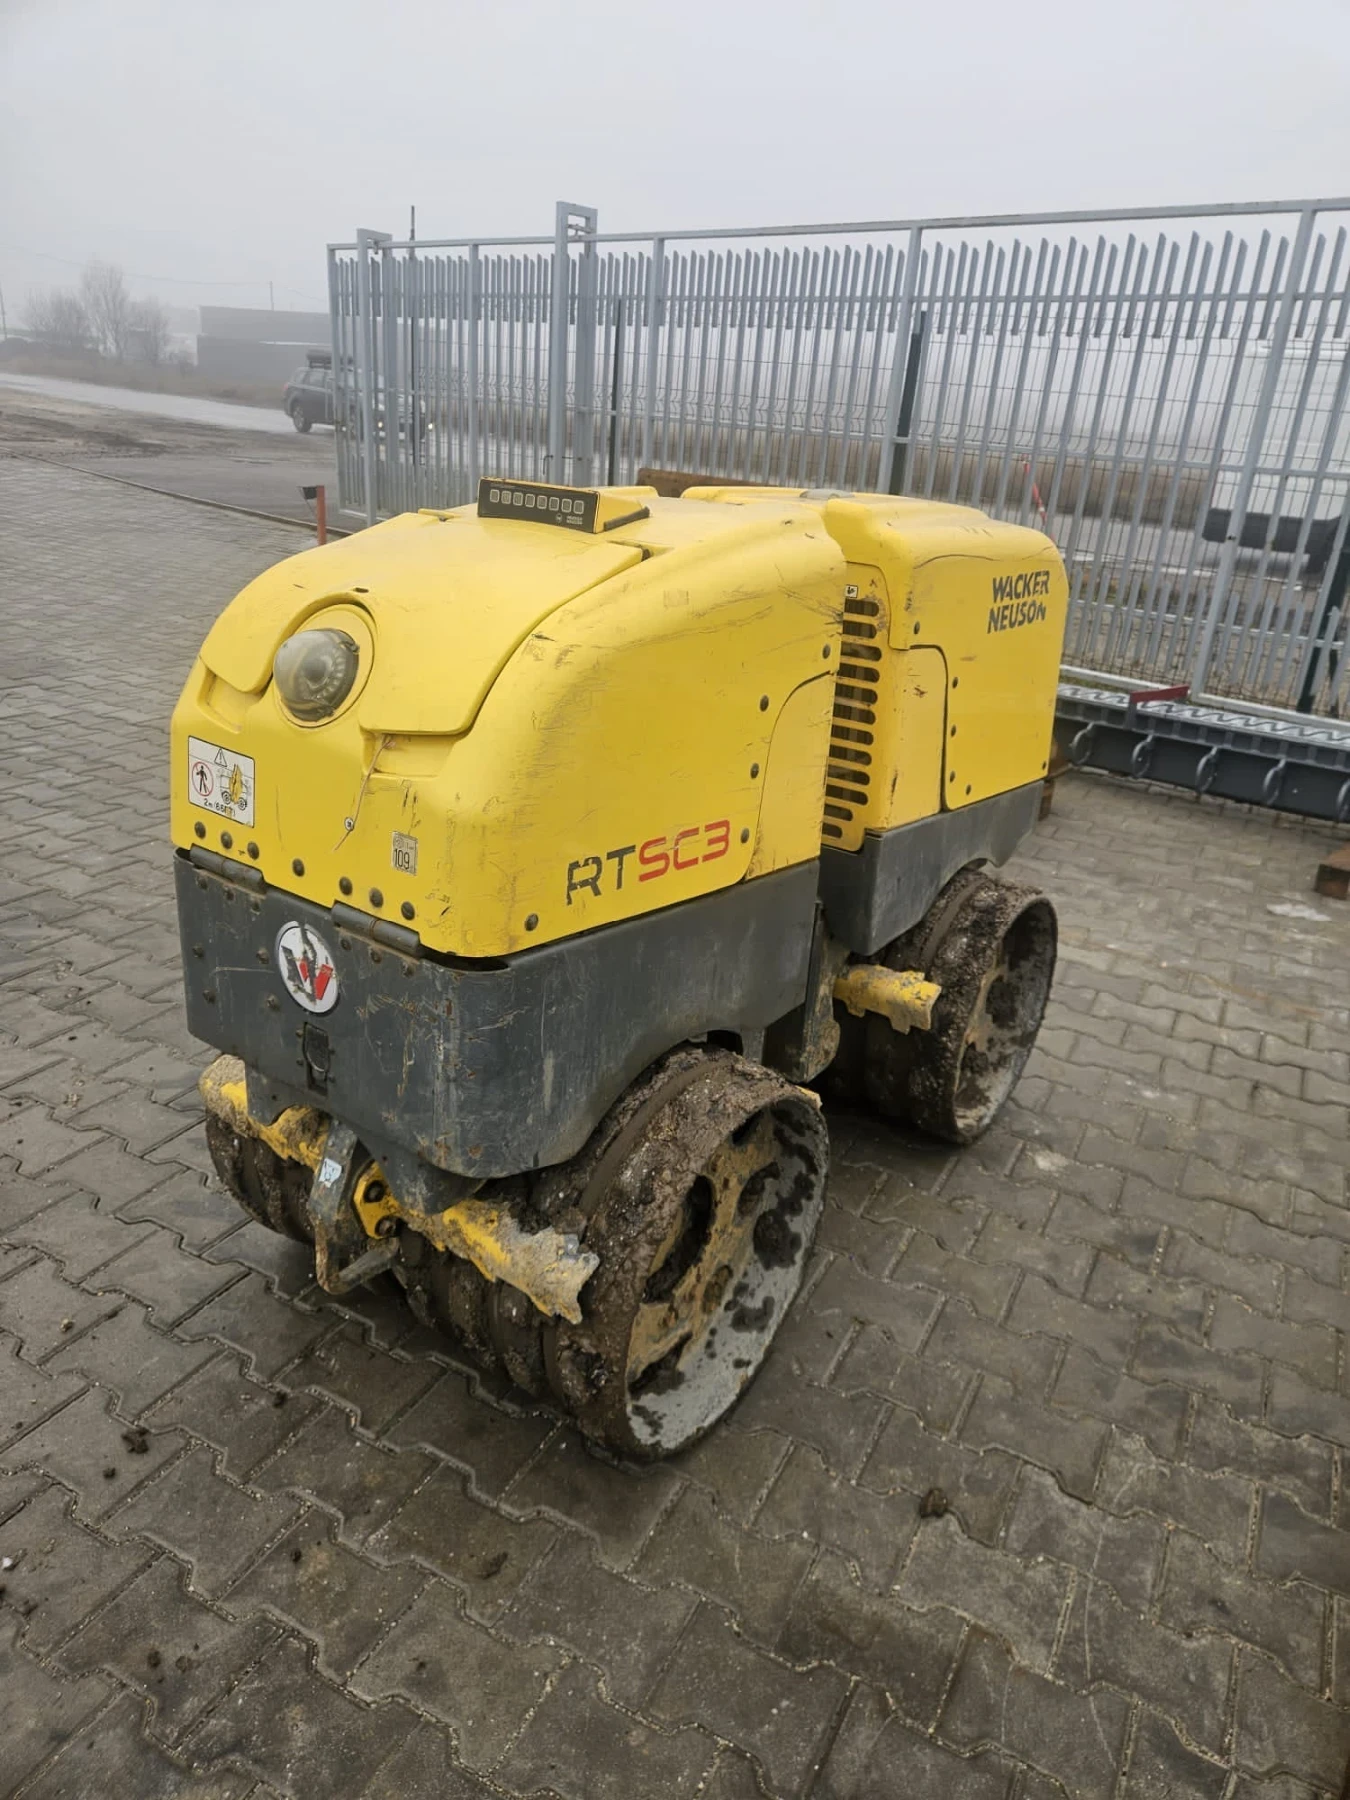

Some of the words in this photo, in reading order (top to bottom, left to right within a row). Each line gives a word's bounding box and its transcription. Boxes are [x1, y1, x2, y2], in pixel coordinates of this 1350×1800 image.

[992, 570, 1050, 603] WACKER
[987, 600, 1046, 634] NEUSON
[394, 848, 410, 870] 109
